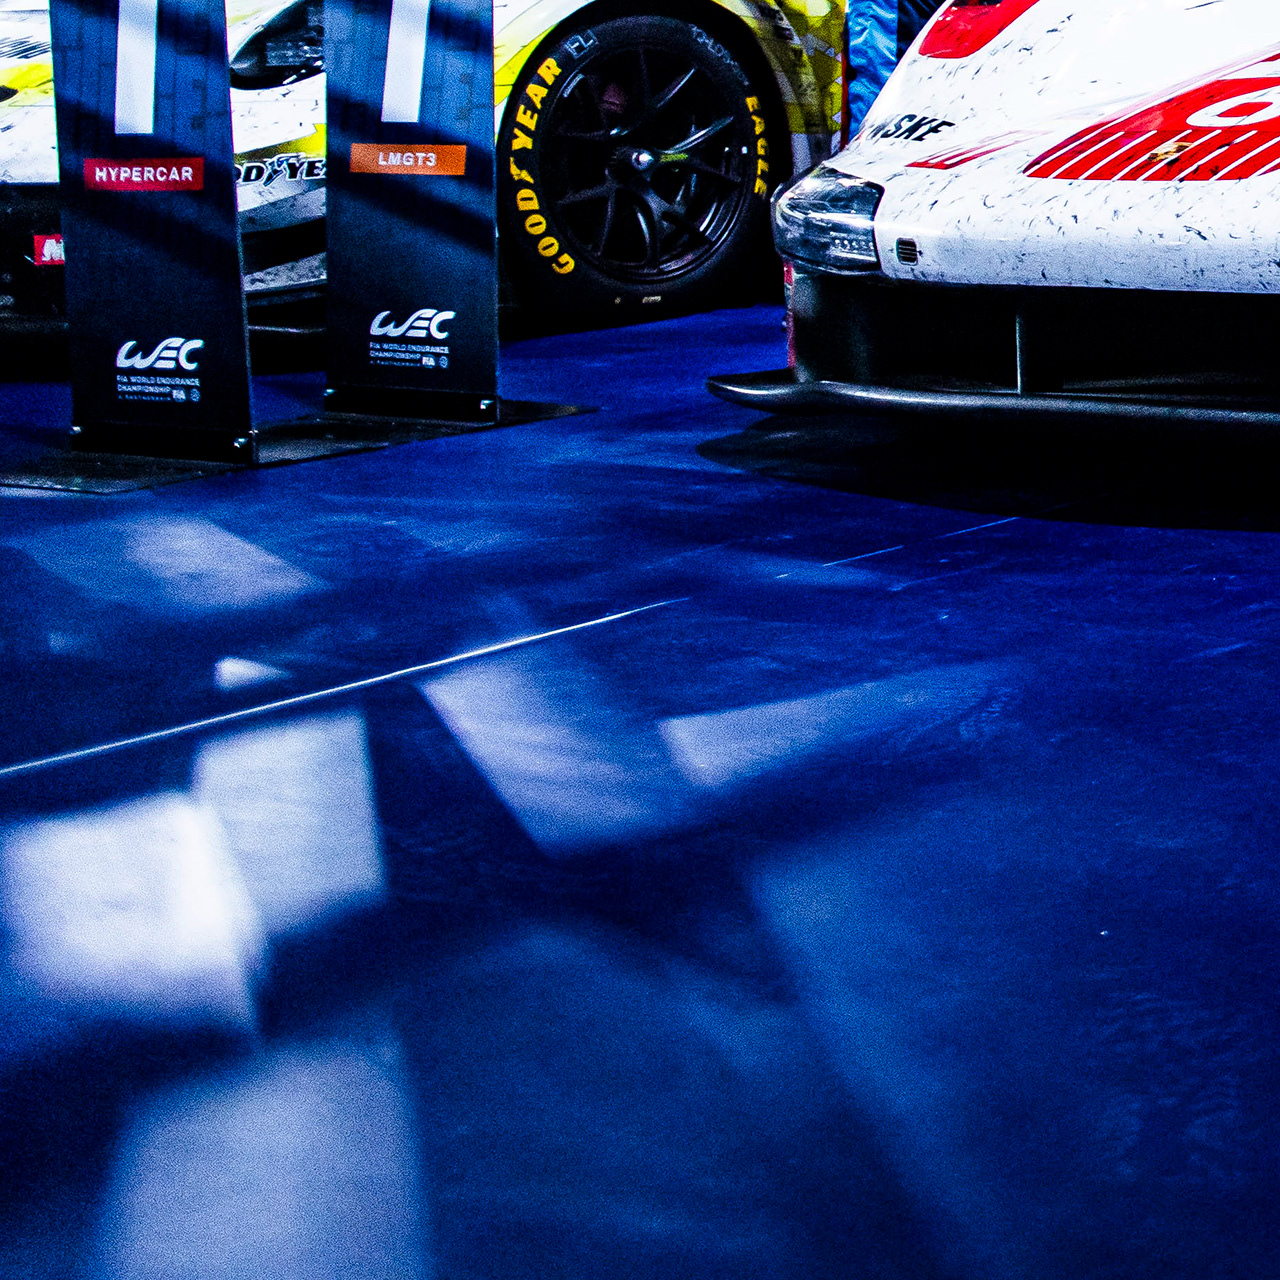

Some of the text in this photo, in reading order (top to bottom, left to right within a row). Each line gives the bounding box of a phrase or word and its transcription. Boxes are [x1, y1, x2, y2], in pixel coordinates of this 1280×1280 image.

[378, 151, 437, 167] LMGT3
[745, 95, 770, 198] EAGLE
[94, 166, 194, 183] HYPERCAR
[369, 308, 457, 340] WEC
[115, 336, 204, 371] WEC
